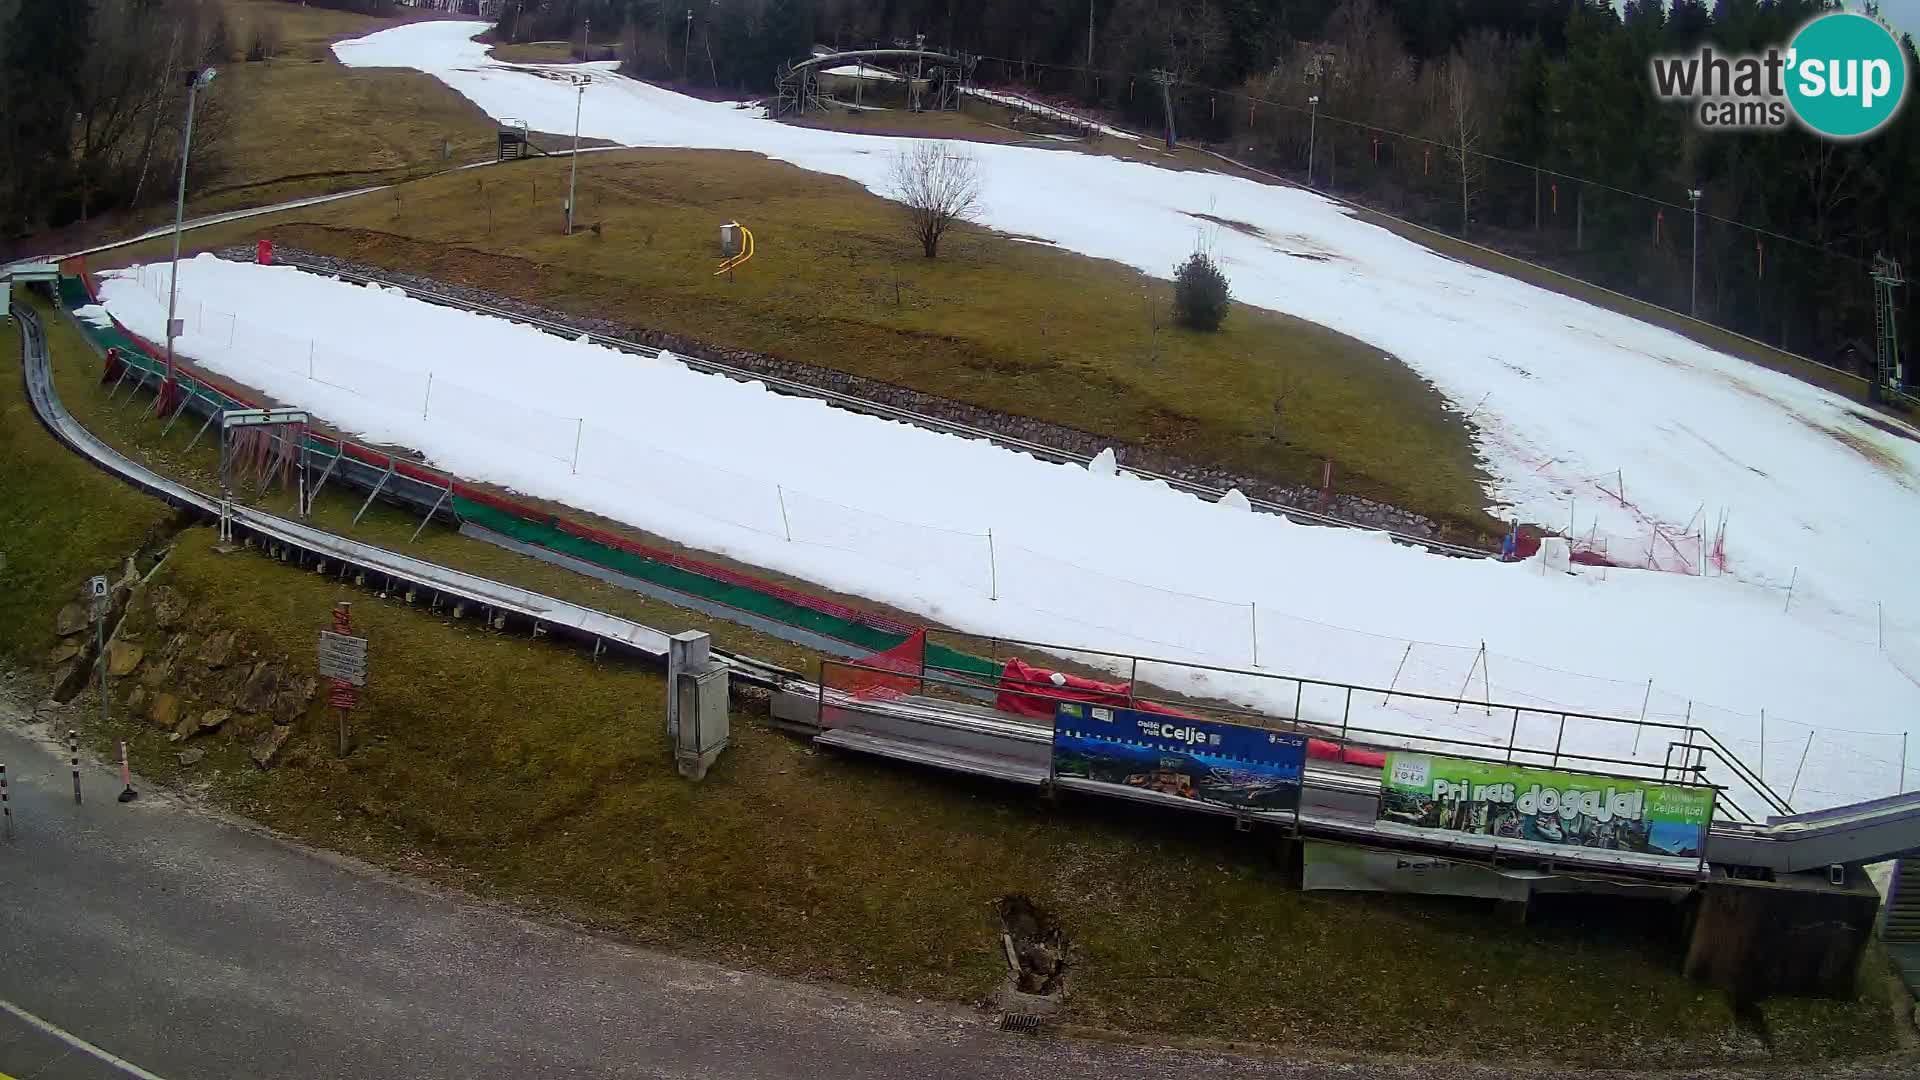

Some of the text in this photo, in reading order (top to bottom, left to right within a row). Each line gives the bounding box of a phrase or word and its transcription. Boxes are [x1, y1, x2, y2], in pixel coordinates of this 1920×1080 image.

[1161, 723, 1207, 745] Celje
[1431, 778, 1469, 802] Pri
[1472, 782, 1516, 804] nas
